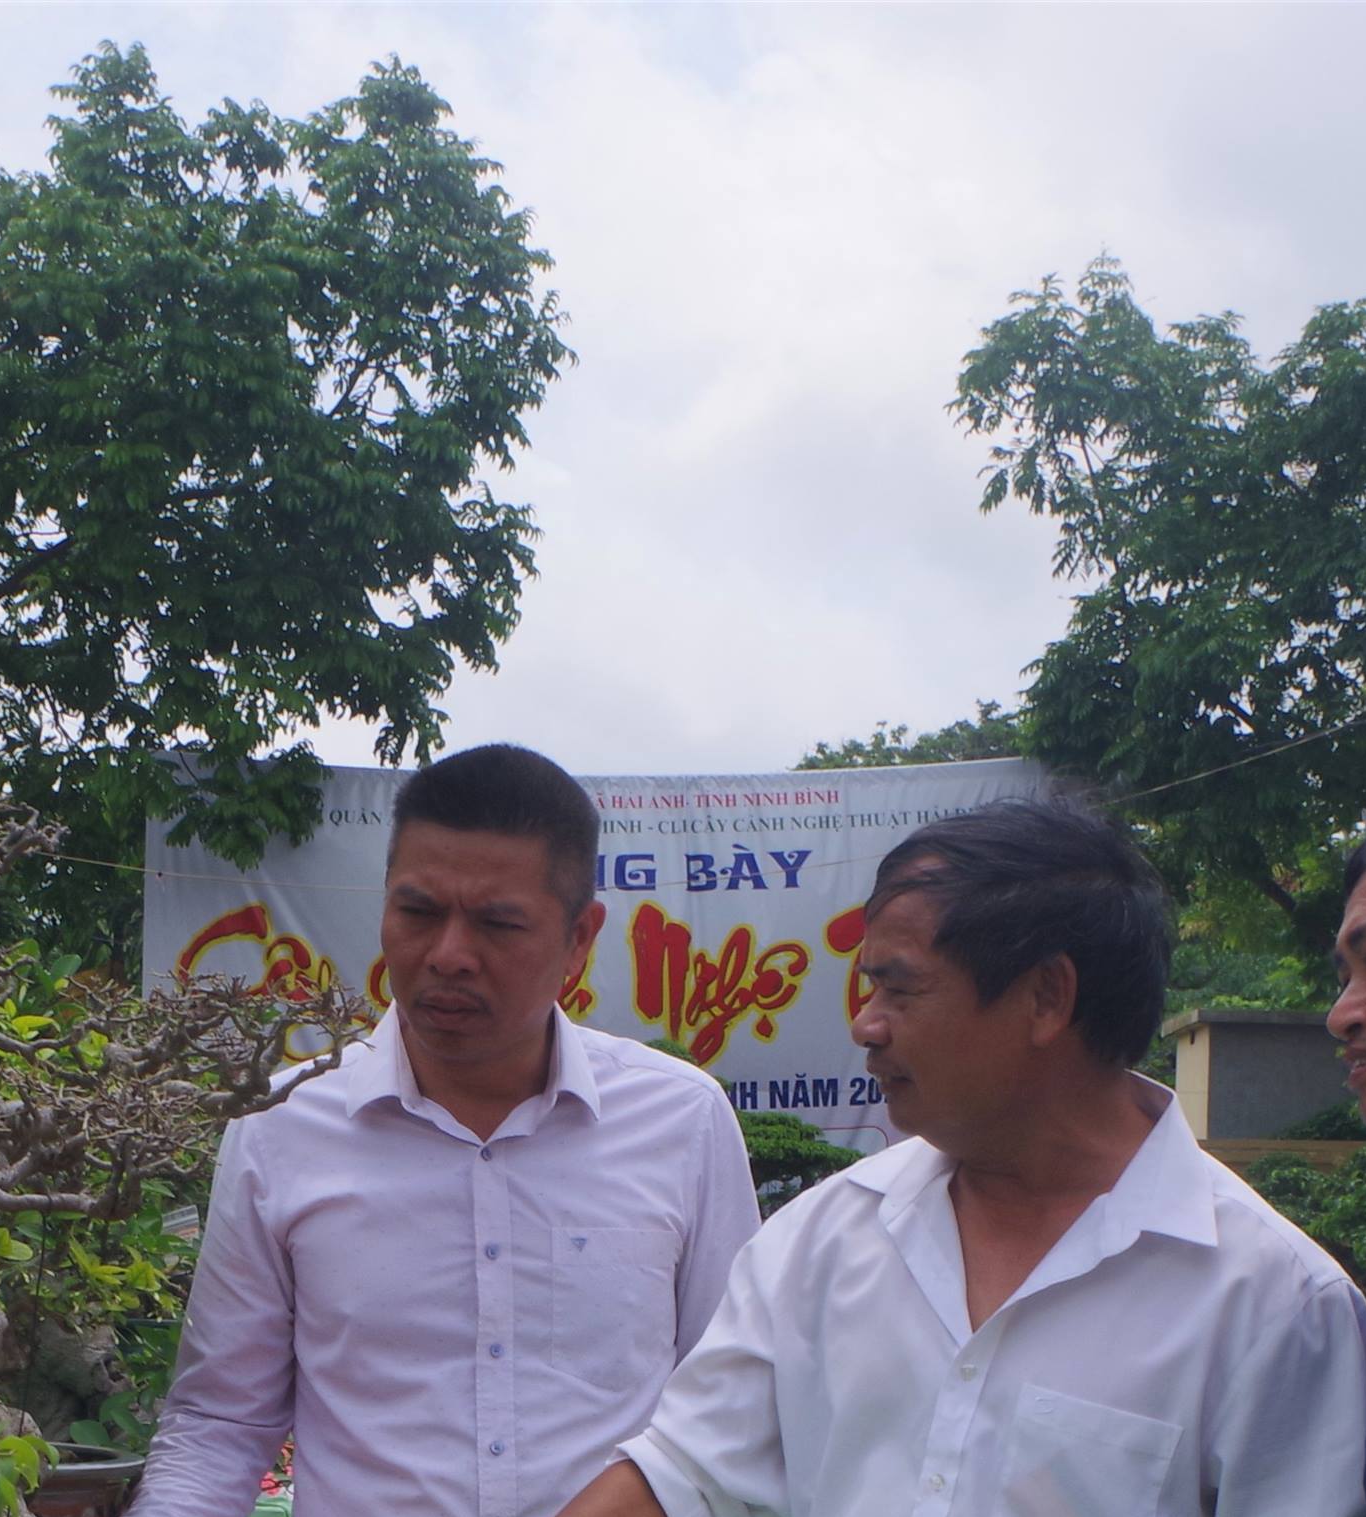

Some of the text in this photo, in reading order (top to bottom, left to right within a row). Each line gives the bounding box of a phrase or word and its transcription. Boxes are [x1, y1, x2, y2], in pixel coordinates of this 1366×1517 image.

[742, 790, 788, 807] NINH
[602, 819, 642, 834] INH
[684, 843, 813, 892] BÀY
[769, 1072, 839, 1109] NĂM
